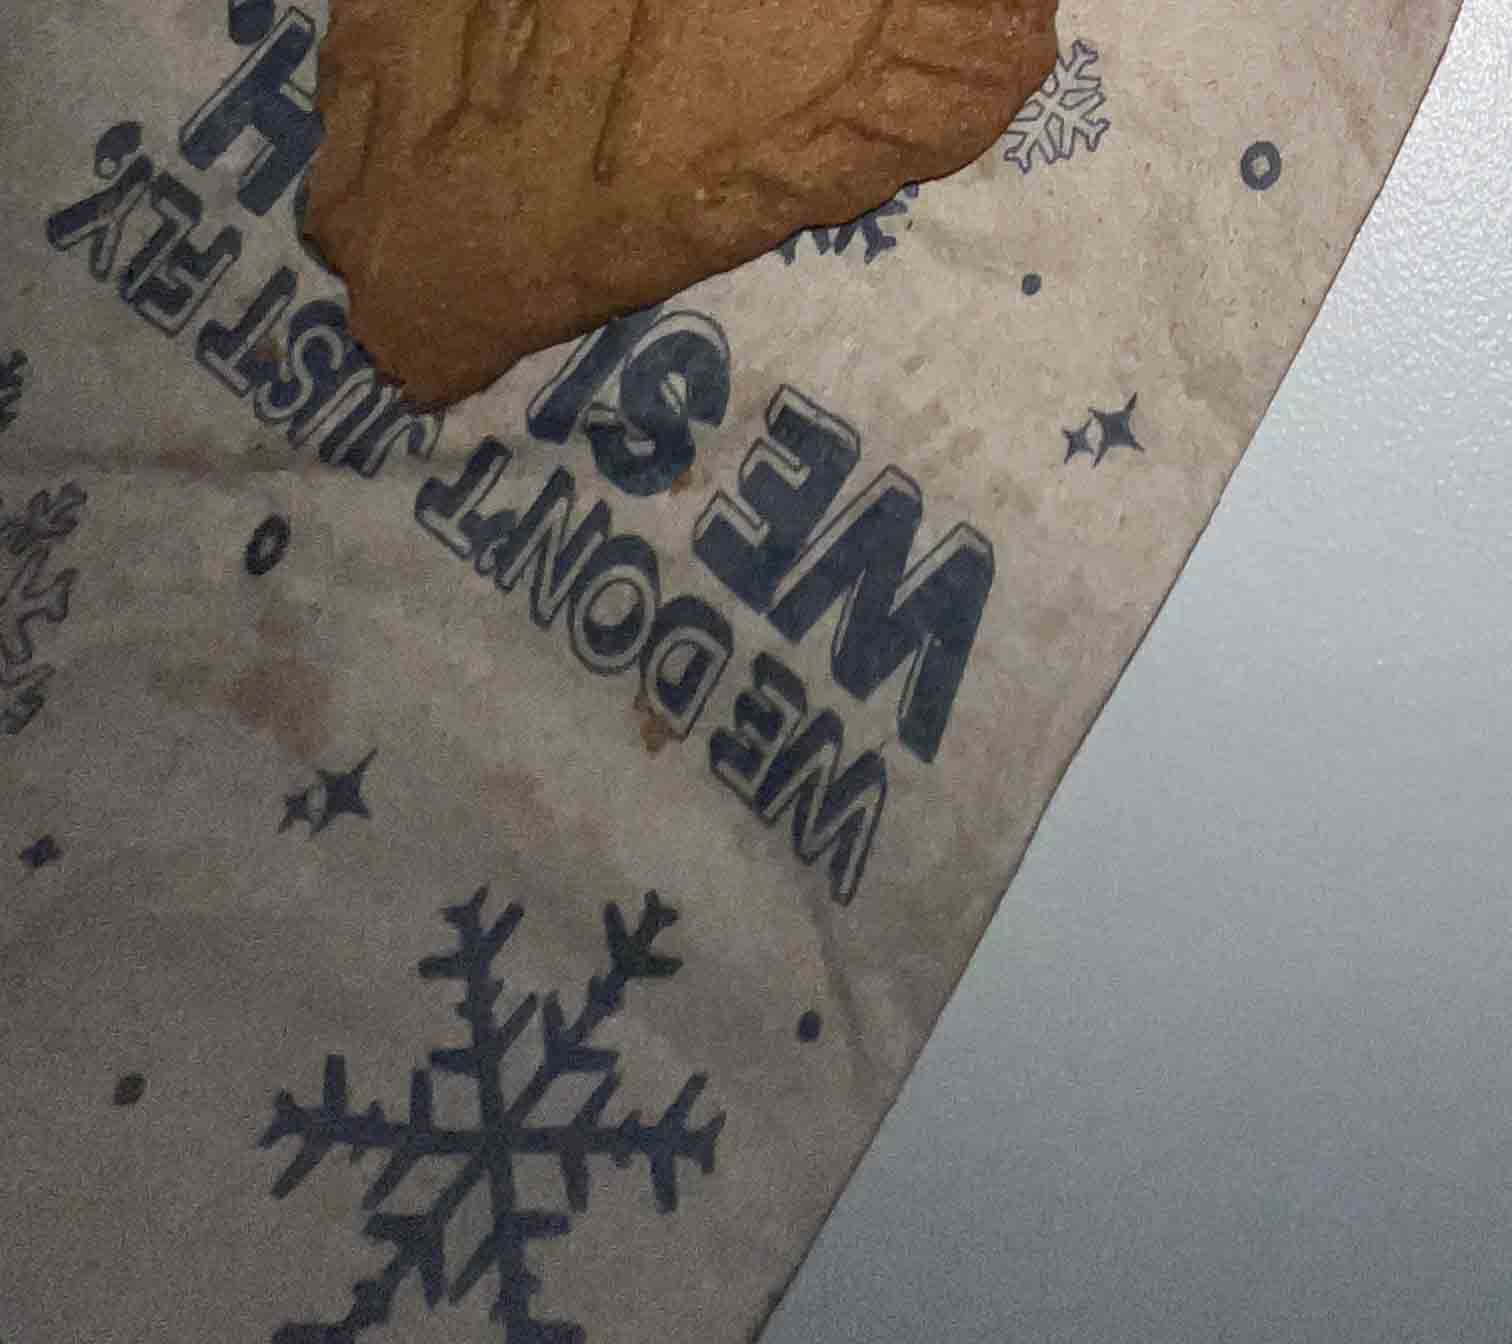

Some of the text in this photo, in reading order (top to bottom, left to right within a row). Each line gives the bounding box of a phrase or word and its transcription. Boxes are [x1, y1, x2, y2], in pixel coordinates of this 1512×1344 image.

[197, 265, 446, 480] JUST
[414, 434, 734, 739] DON'T
[692, 384, 996, 764] WE
[709, 653, 889, 907] WE
